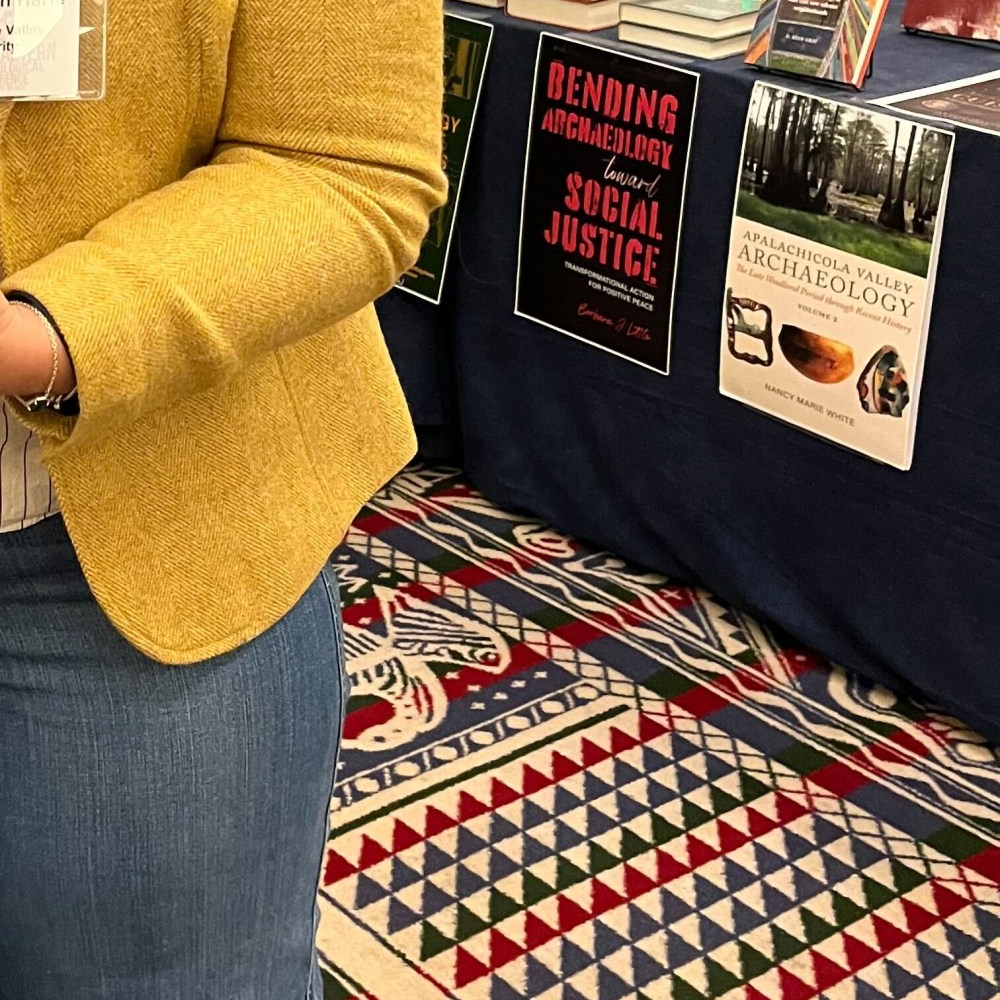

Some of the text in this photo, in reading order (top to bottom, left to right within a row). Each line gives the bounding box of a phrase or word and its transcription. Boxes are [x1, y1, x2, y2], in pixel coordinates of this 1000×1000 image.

[547, 61, 679, 135] BENDING
[541, 108, 674, 170] ARCHAEOLOGY
[564, 172, 663, 241] SOCIAL
[601, 155, 662, 198] toward
[544, 211, 660, 285] JUSTICE
[743, 230, 914, 295] APALACHICOLA VALLEY
[564, 261, 655, 301] TRANSFORMATIONAL ACTION
[588, 280, 654, 312] FOR POSITIVE PEACE
[736, 264, 913, 335] The Late Woodland Period through Recent History
[737, 244, 916, 318] ARCHAEOLOGY
[797, 303, 831, 320] VOLUME
[764, 383, 856, 427] NANCY MARIE WHITE
